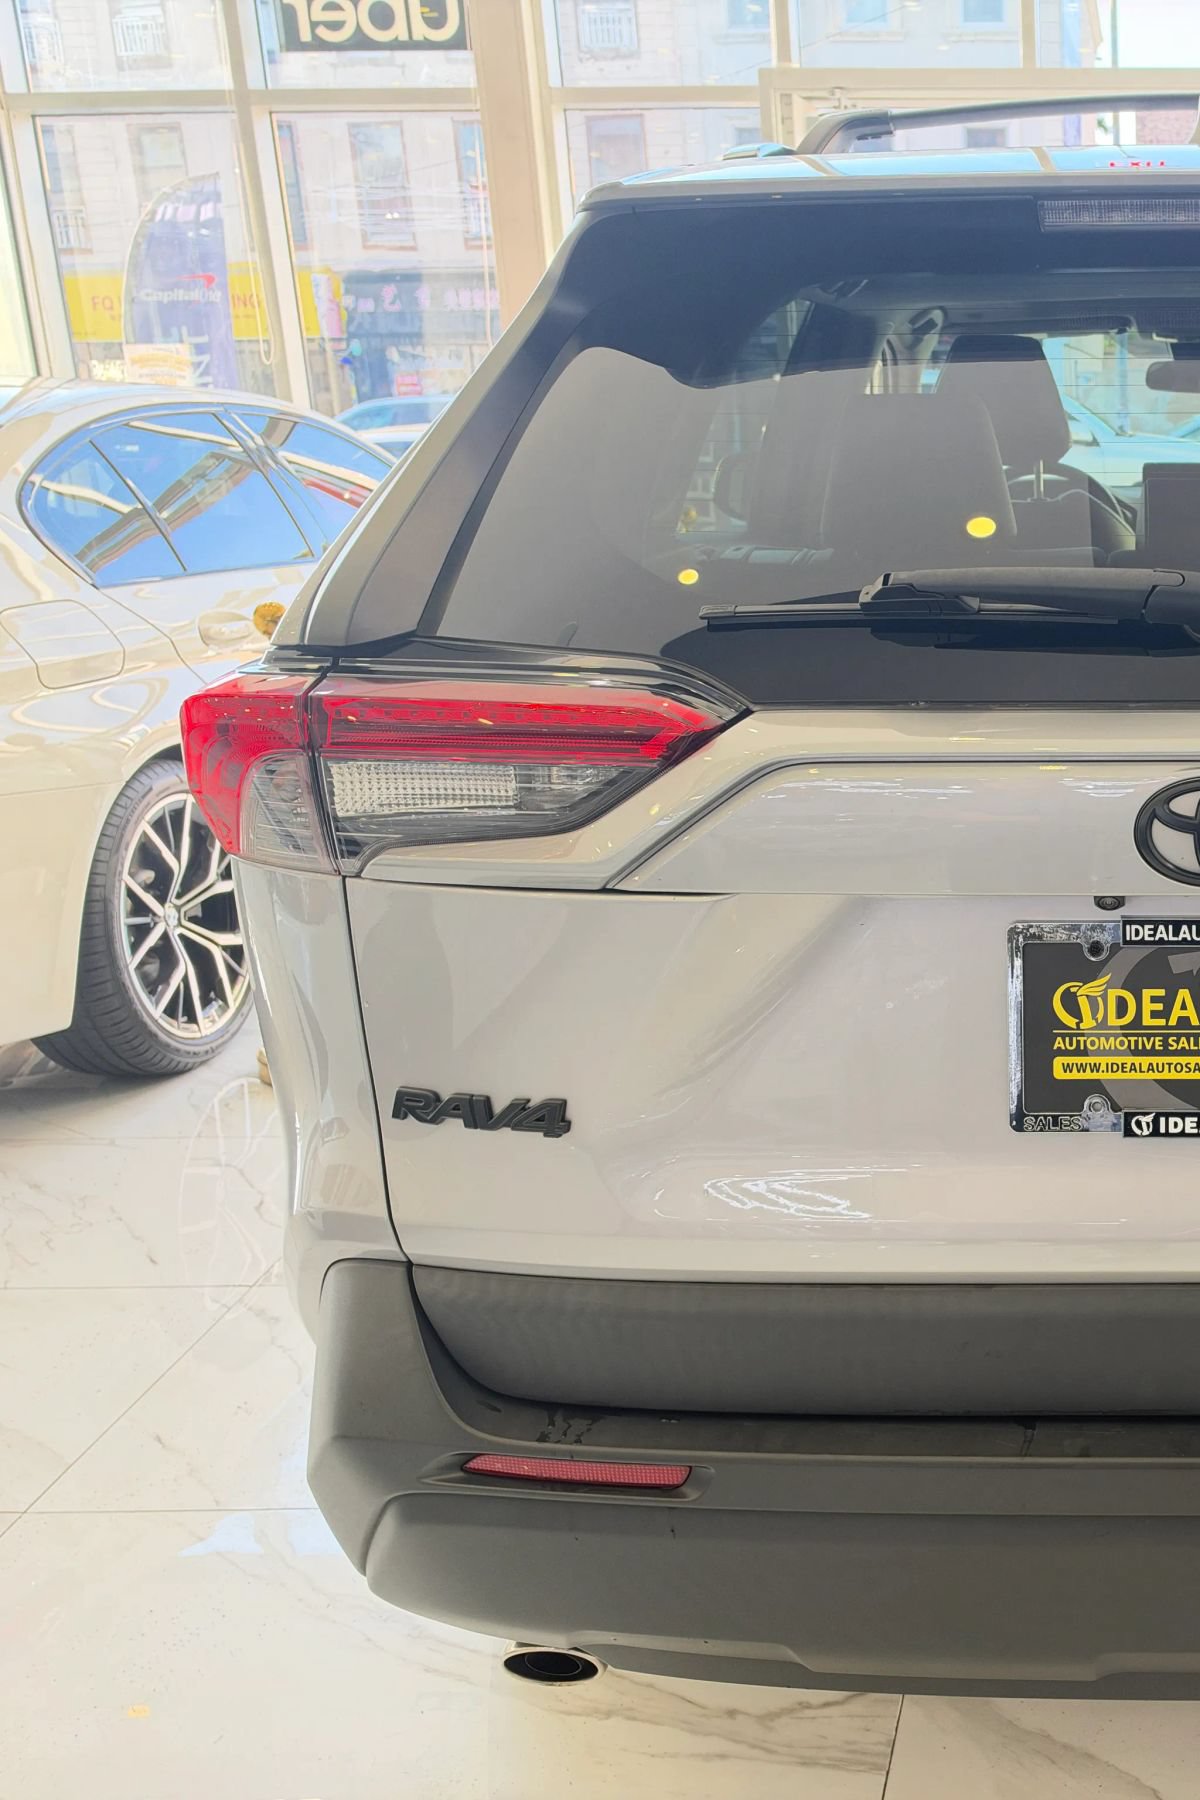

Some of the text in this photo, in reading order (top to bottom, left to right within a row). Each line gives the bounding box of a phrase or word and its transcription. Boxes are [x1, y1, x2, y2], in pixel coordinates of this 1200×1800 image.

[1053, 1036, 1163, 1050] AUTOMOTIVE
[391, 1086, 572, 1138] RAV4
[1023, 1116, 1082, 1131] SALES
